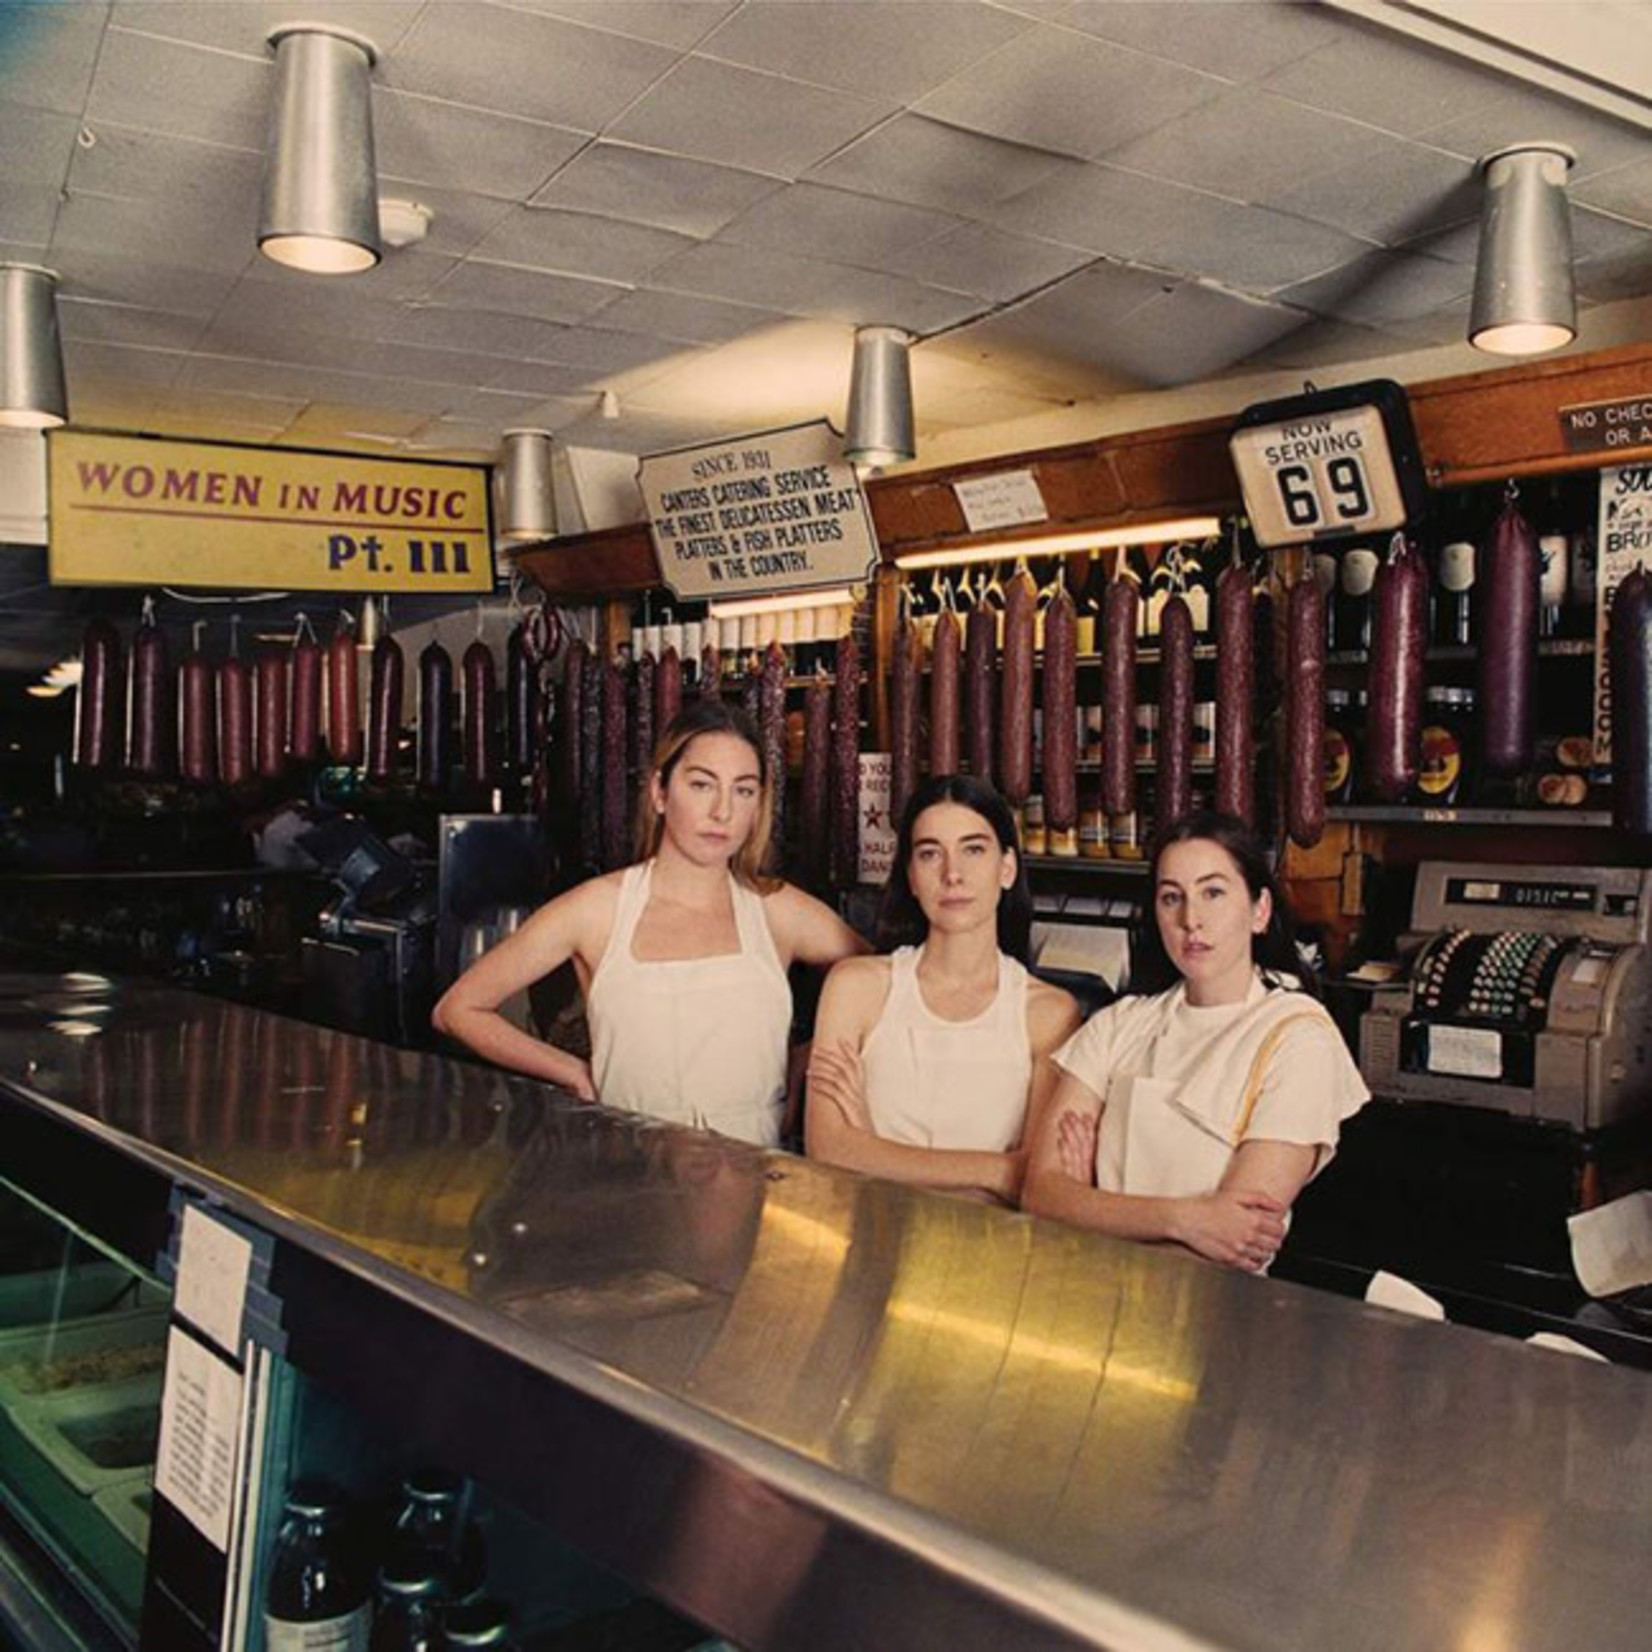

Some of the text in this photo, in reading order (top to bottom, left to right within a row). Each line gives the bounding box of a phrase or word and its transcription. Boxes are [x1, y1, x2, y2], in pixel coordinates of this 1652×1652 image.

[1282, 419, 1332, 441] NOW
[1570, 411, 1597, 428] NO
[1605, 427, 1631, 446] OR
[692, 451, 738, 481] SINCE
[1265, 431, 1363, 465] SERVING
[76, 461, 468, 519] WOMEN IN MUSIC
[660, 465, 832, 513] CANTERS CATERING SERVICE
[1277, 457, 1369, 526] 69
[655, 518, 676, 539] THE
[678, 511, 716, 535] FINEST
[719, 496, 812, 530] DELICATESSEN
[328, 534, 471, 573] Pt. III
[675, 518, 843, 560] PLATTERS & FISH PLATTERS
[708, 550, 814, 581] IN THE COUNTRY.
